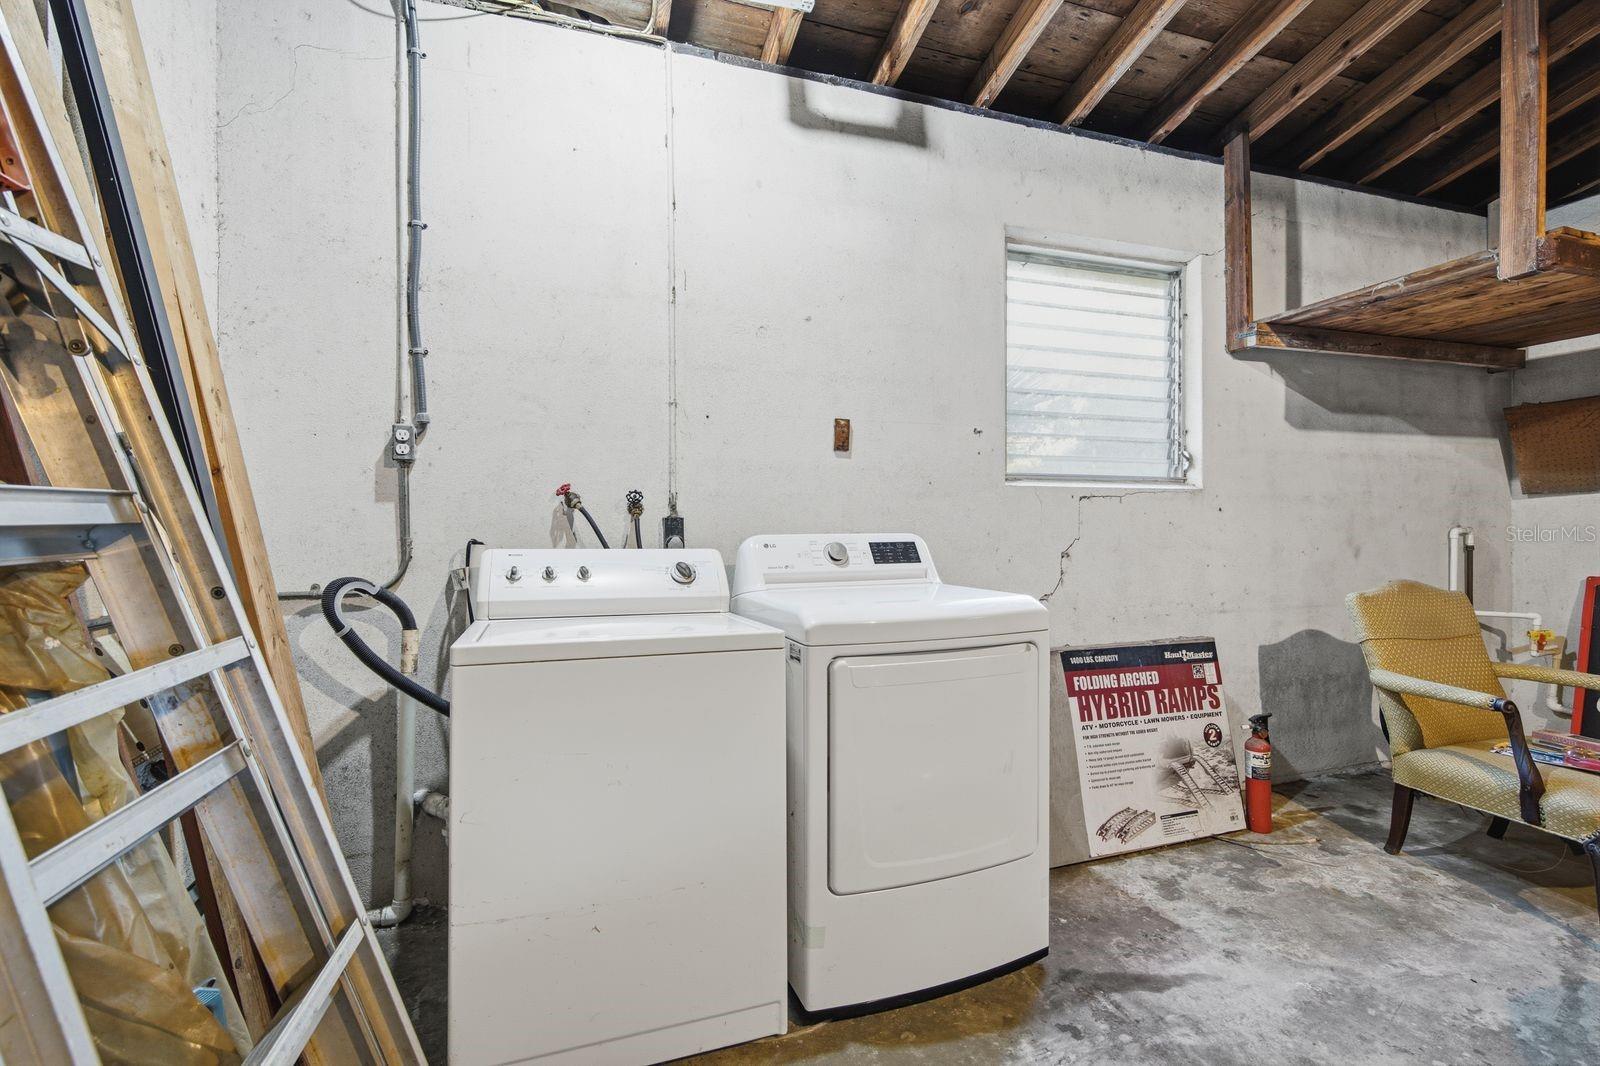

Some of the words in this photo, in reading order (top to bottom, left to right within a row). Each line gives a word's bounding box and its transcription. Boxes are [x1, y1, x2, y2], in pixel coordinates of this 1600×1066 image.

[1095, 654, 1119, 663] CAPACITY
[1164, 651, 1182, 659] Haul
[1186, 651, 1214, 659] Master
[1073, 673, 1118, 691] FOLDING
[1119, 671, 1160, 687] ARCHED
[1077, 690, 1152, 723] HYBRID
[1154, 685, 1221, 714] RAMPS
[1099, 720, 1139, 729] MOTORCYCLE
[1144, 717, 1160, 725] LAWN
[1161, 715, 1186, 723] MOWERS
[1190, 711, 1222, 720] EQUIPMENT
[1208, 728, 1217, 741] 2
